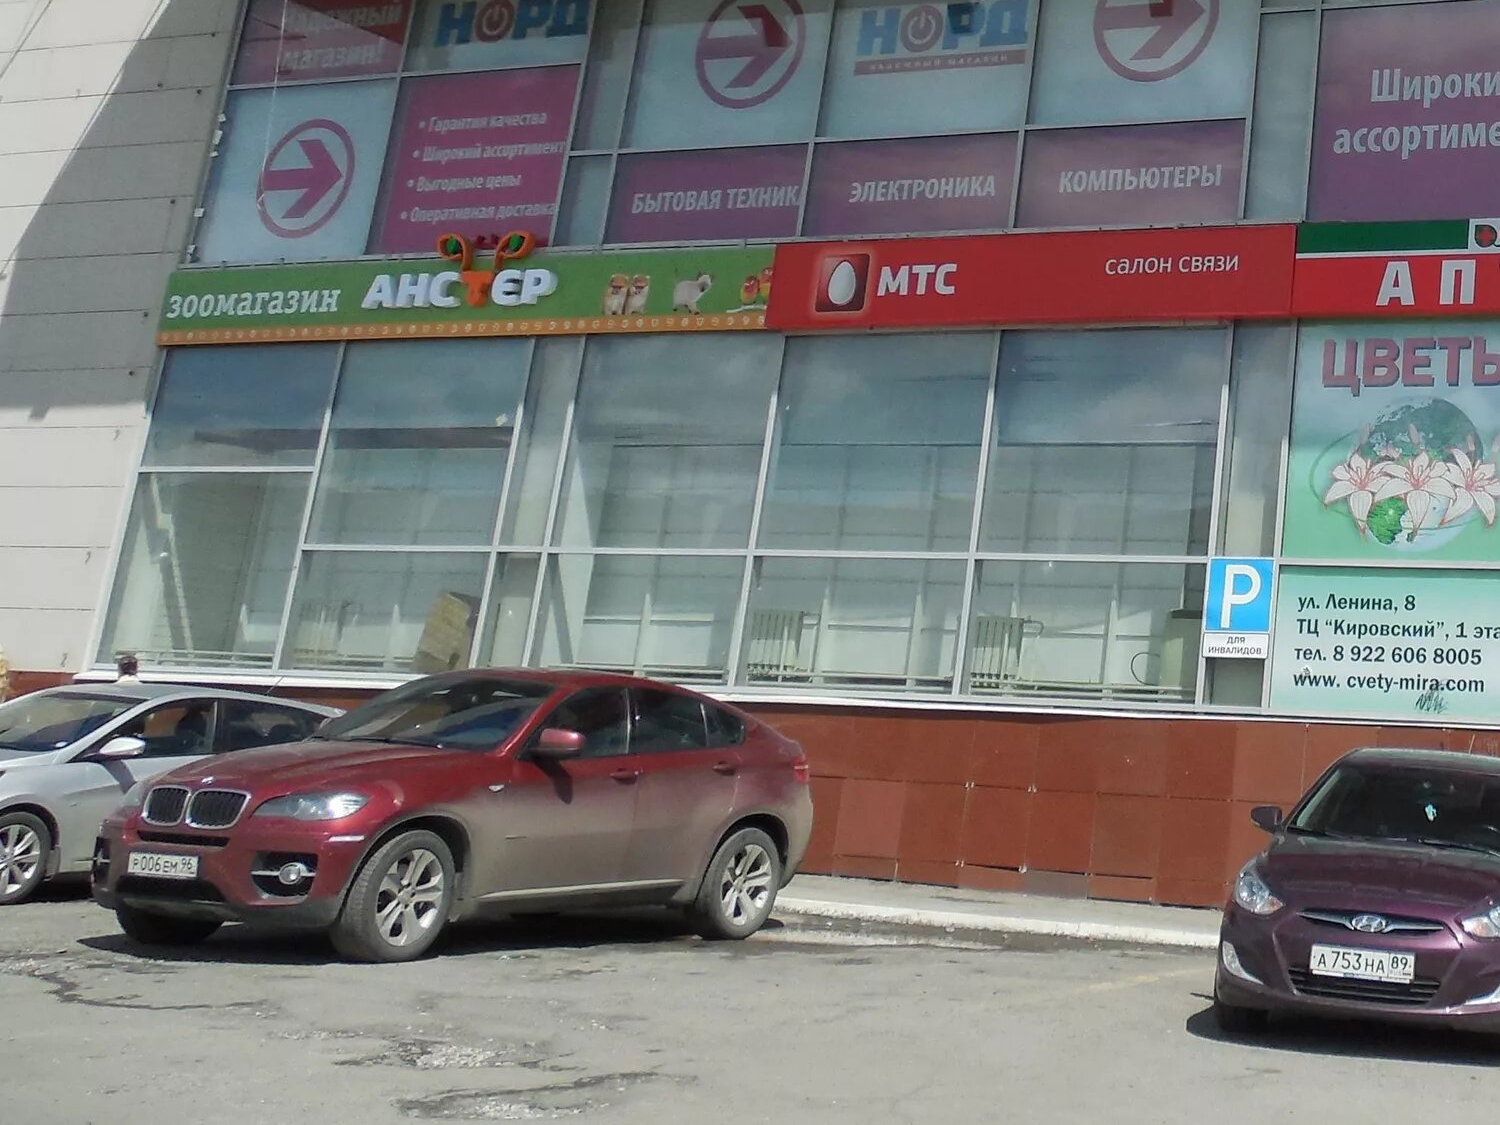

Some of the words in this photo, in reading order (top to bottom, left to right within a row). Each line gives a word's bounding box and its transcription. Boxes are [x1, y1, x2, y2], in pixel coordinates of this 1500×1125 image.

[849, 174, 996, 205] ЭЛЕКТРОНИКА
[1058, 164, 1222, 194] КОМПЬЮТЕРЫ
[631, 189, 723, 214] БЫТОВАЯ
[1105, 256, 1173, 275] салон
[1178, 254, 1239, 273] связи
[876, 263, 958, 297] МТС
[166, 288, 341, 319] зоомагазин
[1297, 596, 1320, 611] ул.
[1325, 594, 1398, 614] Ленина,
[1404, 595, 1416, 611] 8
[1296, 618, 1320, 637] ТЦ
[1456, 622, 1468, 638] 1
[1227, 636, 1245, 644] ДЛЯ
[1295, 647, 1327, 662] тел.
[1333, 645, 1344, 662] 8
[1350, 646, 1385, 663] 922
[1391, 647, 1427, 664] 606
[1432, 648, 1482, 665] 8005
[1391, 956, 1408, 970] 89
